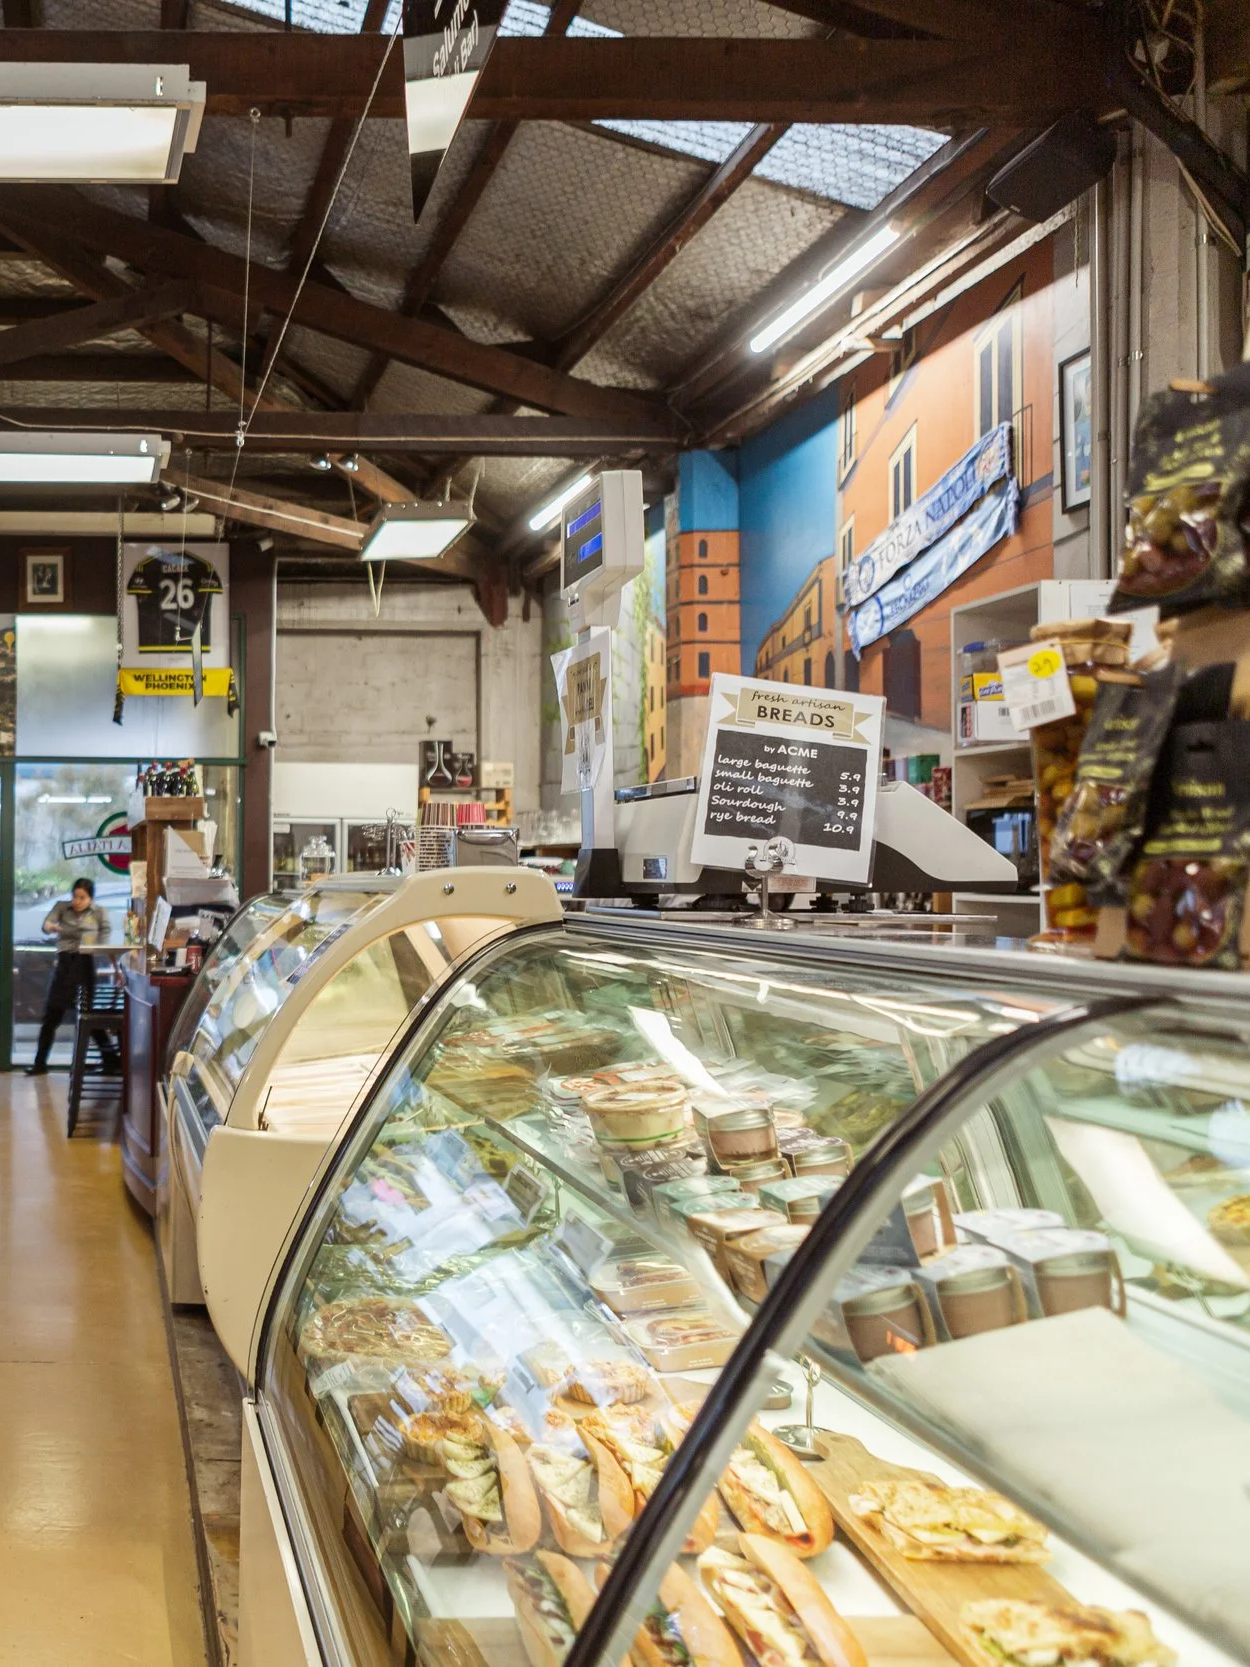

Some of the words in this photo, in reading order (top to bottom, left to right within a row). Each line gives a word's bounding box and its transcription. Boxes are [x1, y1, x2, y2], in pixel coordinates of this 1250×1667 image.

[878, 521, 922, 571] FORZA
[159, 578, 195, 611] 26
[145, 683, 195, 691] PHOENIX
[751, 690, 788, 704] fresh
[792, 697, 845, 712] artisan
[756, 705, 835, 728] BREADS
[764, 745, 775, 755] by
[777, 744, 818, 759] ACME
[717, 754, 751, 769] large
[754, 758, 811, 775] baguette
[839, 772, 861, 782] 5.9
[714, 769, 754, 781] small
[757, 773, 814, 789] baguette
[838, 784, 860, 795] 3.9
[711, 795, 786, 813] Sourdough
[836, 810, 858, 821] 9.9
[737, 784, 764, 796] roll
[837, 797, 859, 808] 3.9
[709, 811, 733, 822] rye
[735, 811, 776, 825] bread
[822, 822, 855, 835] 10.9
